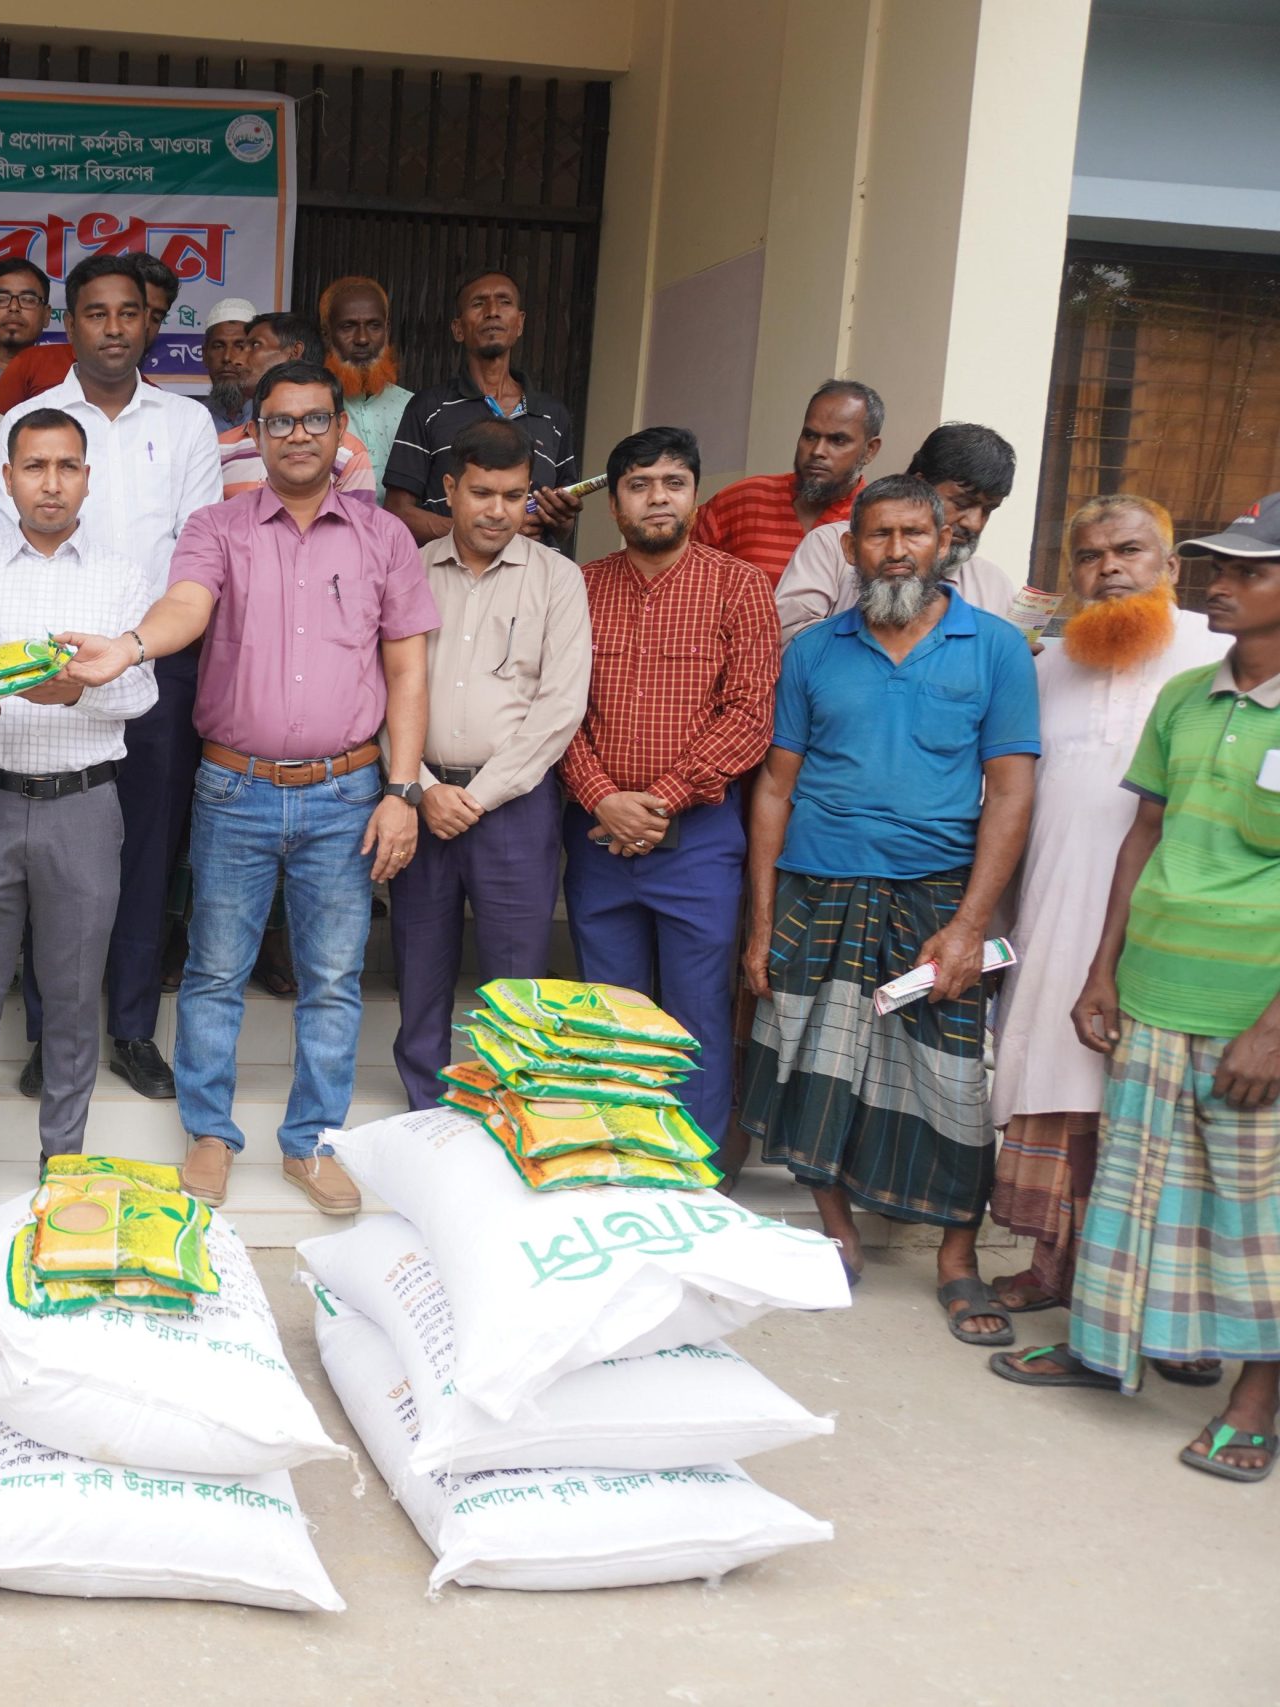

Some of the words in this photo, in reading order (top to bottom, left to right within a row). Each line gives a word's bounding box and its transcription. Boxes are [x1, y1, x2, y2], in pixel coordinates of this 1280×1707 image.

[9, 131, 76, 151] প্রণোদনা
[149, 136, 213, 155] আওতায়
[32, 165, 45, 179] ও
[51, 164, 80, 180] সার
[85, 160, 154, 182] বিতরণের
[73, 1469, 113, 1498] কৃষি
[123, 1468, 185, 1500] উন্নয়ন
[192, 1482, 294, 1518] কর্পোরেশন
[453, 1484, 544, 1515] বাংলাদেশ
[551, 1478, 588, 1506] কৃষি
[593, 1472, 654, 1496] উন্নয়ন
